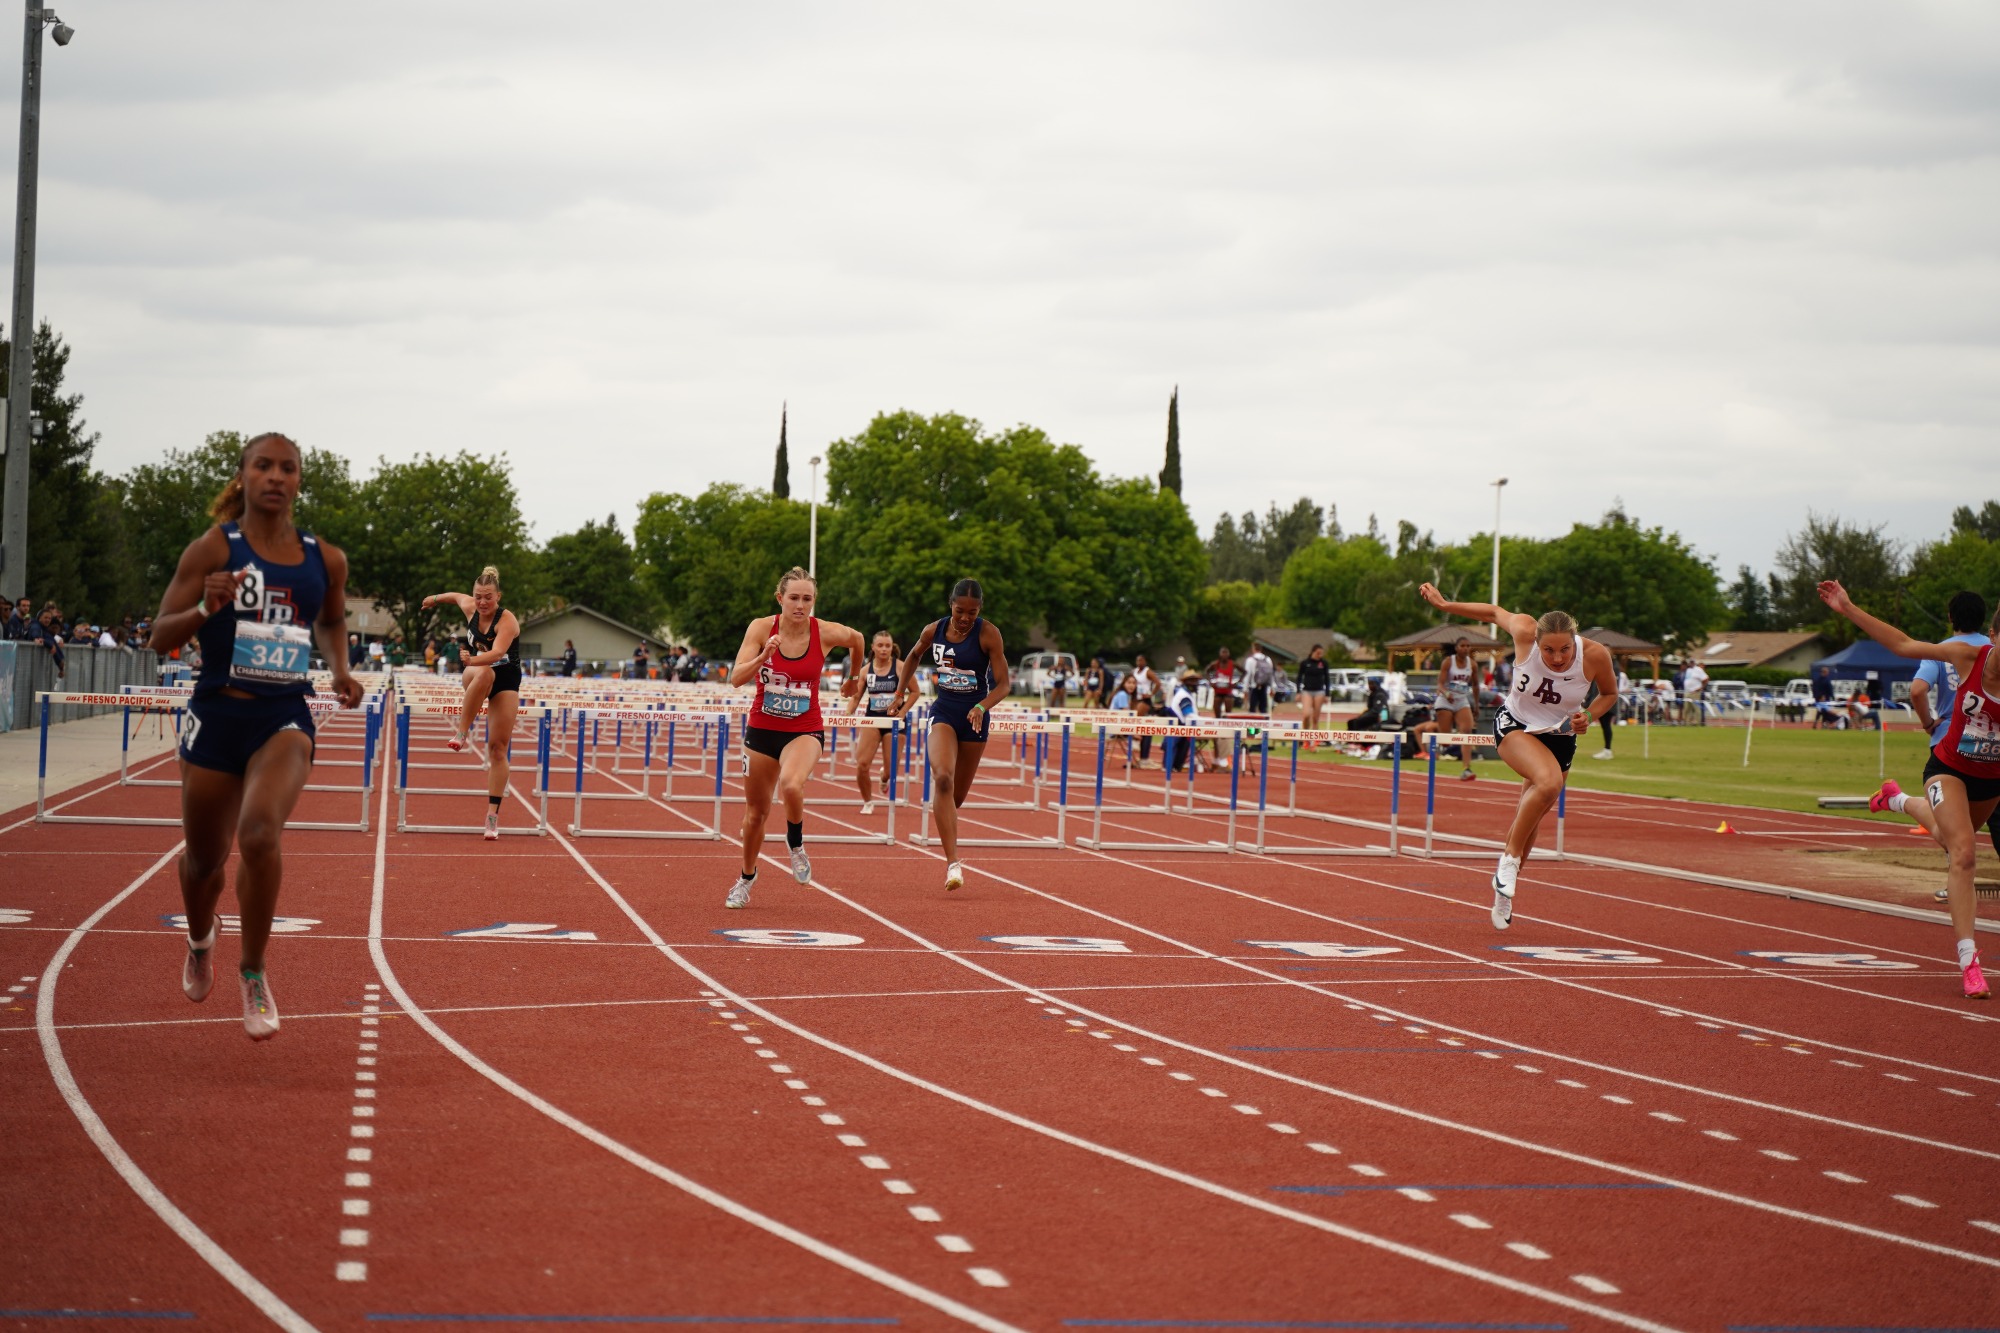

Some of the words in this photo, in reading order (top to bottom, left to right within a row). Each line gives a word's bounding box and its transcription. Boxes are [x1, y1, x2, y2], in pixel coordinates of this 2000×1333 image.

[241, 574, 258, 609] 8
[250, 645, 299, 669] 347
[935, 645, 942, 663] 5
[236, 667, 305, 680] CHAMPIONSHIPS
[761, 668, 770, 684] 6
[868, 675, 874, 685] 4
[1517, 674, 1530, 693] 3
[82, 694, 116, 704] FRESNO
[119, 696, 153, 706] PACIFIC
[773, 697, 799, 711] 201
[1964, 695, 1980, 716] 2
[306, 703, 333, 711] ACIFIC
[442, 706, 462, 715] FRES
[653, 713, 686, 721] PACIFIC
[828, 717, 857, 726] PACIFIC
[999, 722, 1028, 731] PACIFIC
[1136, 726, 1168, 735] FRESNO
[1170, 727, 1201, 736] PACIFIC
[1300, 731, 1329, 740] FRESNO
[1333, 732, 1360, 741] PACIFIC
[1467, 735, 1495, 745] FRESNO
[1930, 784, 1941, 807] 2
